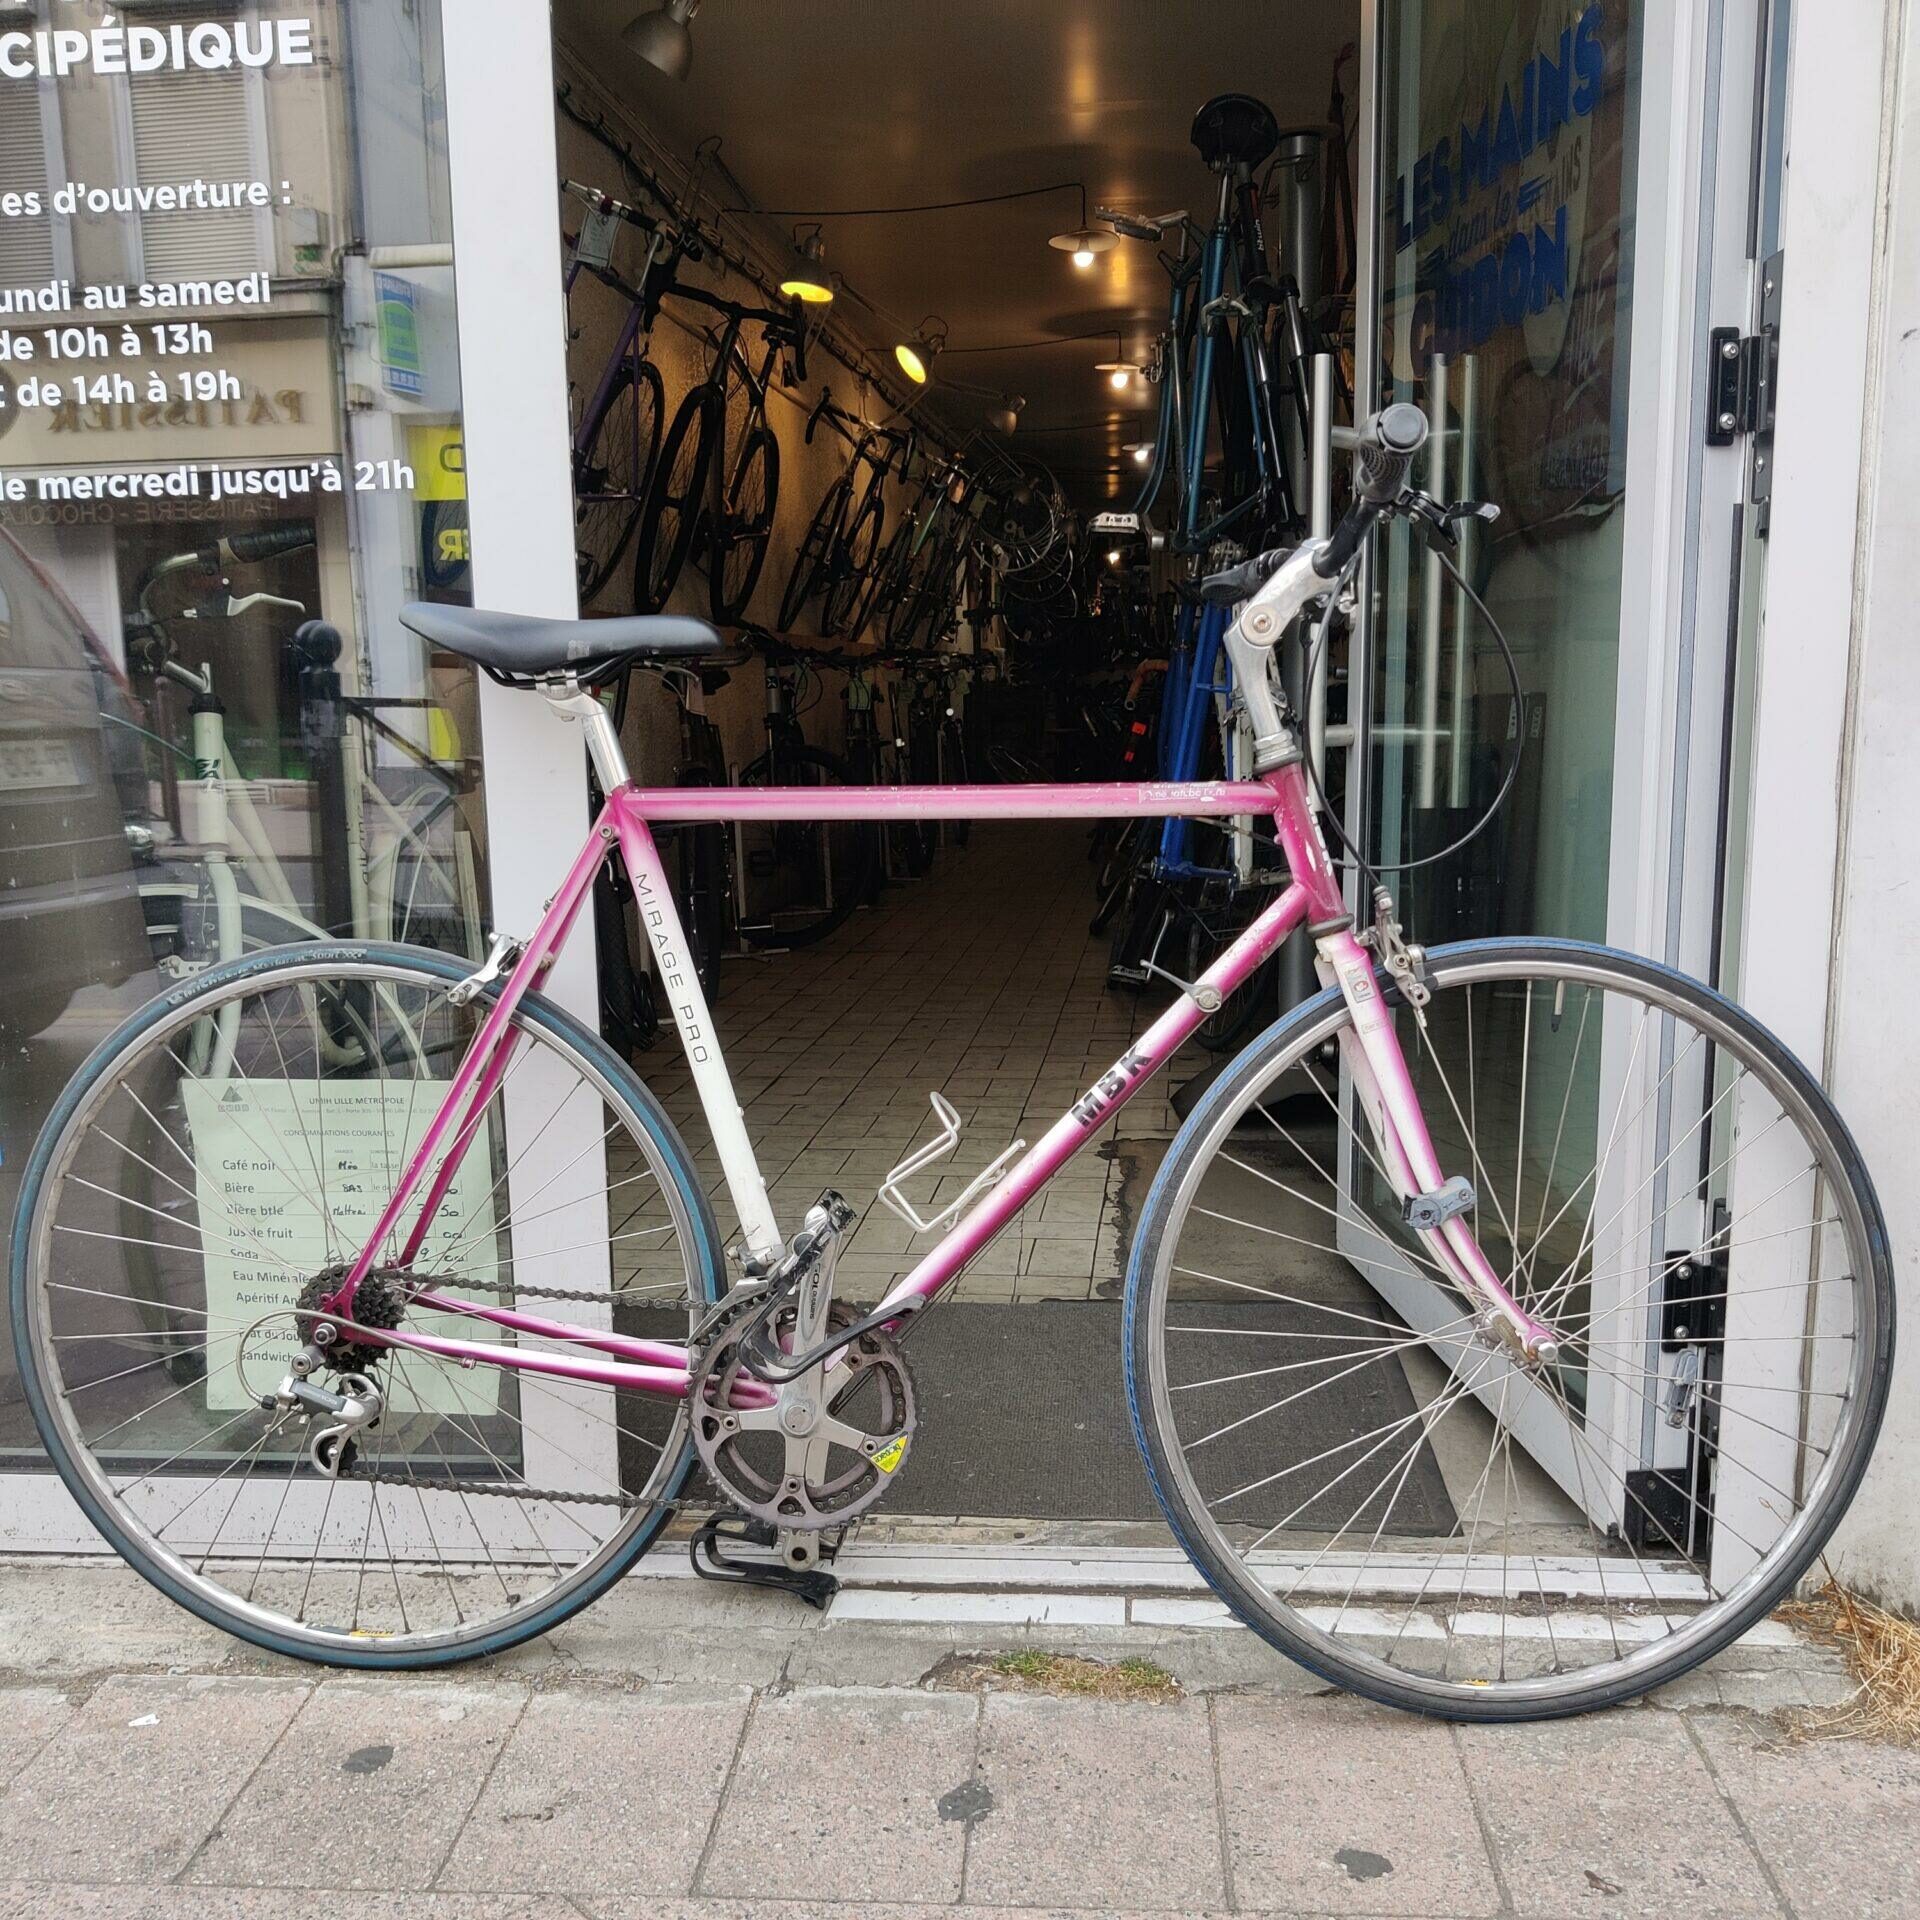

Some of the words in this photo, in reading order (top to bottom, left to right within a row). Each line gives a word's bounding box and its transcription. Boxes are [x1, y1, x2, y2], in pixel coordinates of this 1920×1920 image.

[0, 15, 313, 78] CIPÉDIQUE
[1459, 2, 1604, 206] MAINS
[54, 180, 269, 215] d'ouverture
[84, 286, 127, 310] au
[139, 272, 271, 307] samedi
[44, 327, 108, 358] 10h
[121, 324, 141, 357] à
[153, 324, 213, 354] 13h
[17, 376, 62, 407] de
[72, 373, 135, 405] 14h
[148, 371, 168, 402] à
[179, 369, 241, 400] 19h
[38, 467, 199, 500] mercredi
[211, 465, 342, 501] jusqu'à
[355, 461, 415, 491] 21h
[635, 873, 684, 988] MIRAGE
[679, 1004, 708, 1063] PRO
[334, 1097, 353, 1105] LILLE
[1071, 1044, 1153, 1127] MBK
[222, 1160, 248, 1171] Café
[252, 1160, 276, 1171] noir
[225, 1182, 254, 1194] Bière
[267, 1227, 294, 1239] fruit
[233, 1271, 254, 1281] Eau
[236, 1292, 281, 1304] Apéritif
